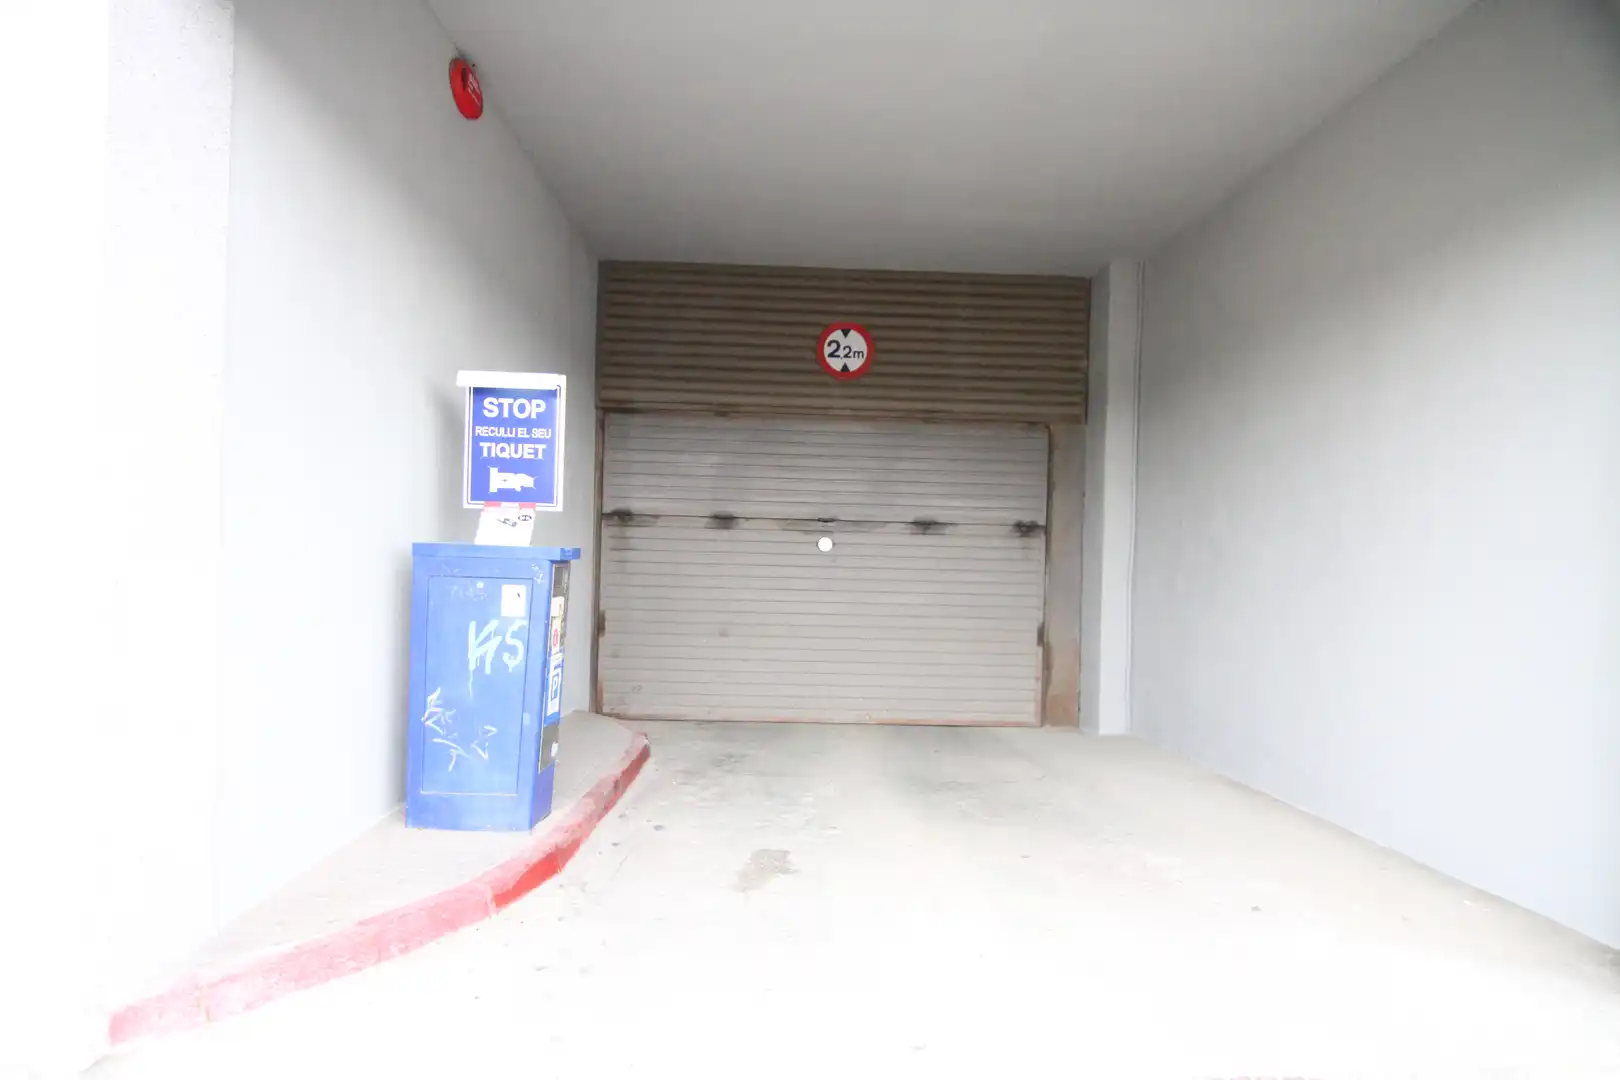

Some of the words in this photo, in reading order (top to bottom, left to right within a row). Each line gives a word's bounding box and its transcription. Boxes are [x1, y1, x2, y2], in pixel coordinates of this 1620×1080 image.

[482, 396, 546, 419] STOP
[475, 426, 515, 437] RECULLI
[518, 427, 530, 438] EL
[531, 428, 552, 439] SEU
[480, 442, 547, 460] TIQUET
